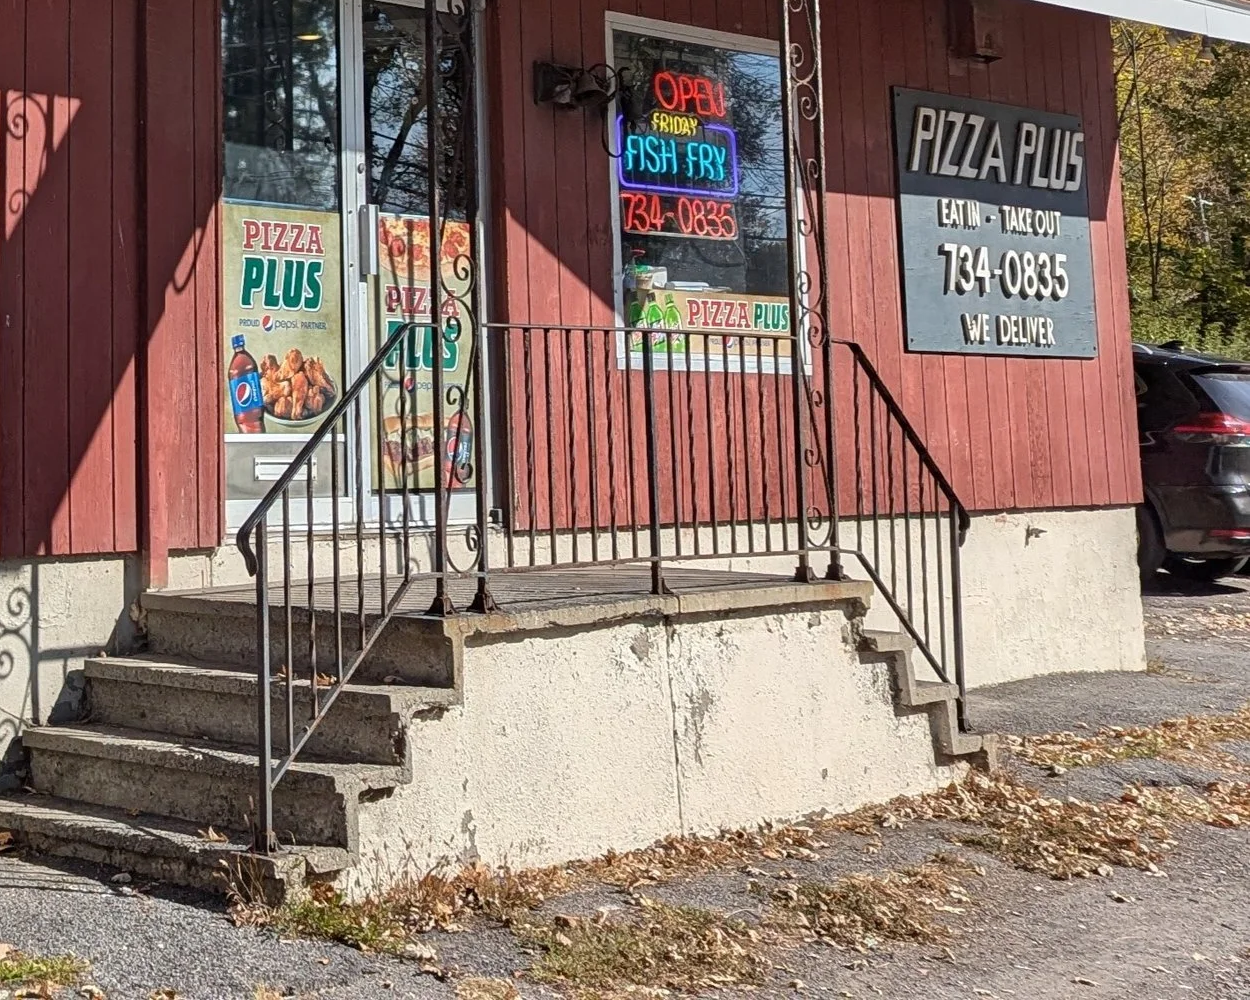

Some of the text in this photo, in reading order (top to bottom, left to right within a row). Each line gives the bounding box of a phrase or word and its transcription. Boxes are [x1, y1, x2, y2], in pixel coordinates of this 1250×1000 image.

[654, 71, 726, 117] OPEN
[651, 112, 698, 136] FRIDAY
[625, 135, 726, 180] FISH FRY
[909, 107, 1084, 191] PIZZA PLUS
[621, 193, 735, 237] 734-0835
[1001, 205, 1032, 233] TAKE
[1035, 210, 1061, 235] OUT
[242, 219, 325, 256] PIZZA
[239, 255, 324, 312] PLUS
[943, 243, 1069, 298] 734-0835
[385, 284, 460, 317] PIZA
[686, 298, 789, 331] PIZZA PLUS
[965, 313, 1056, 345] WE DELIVER
